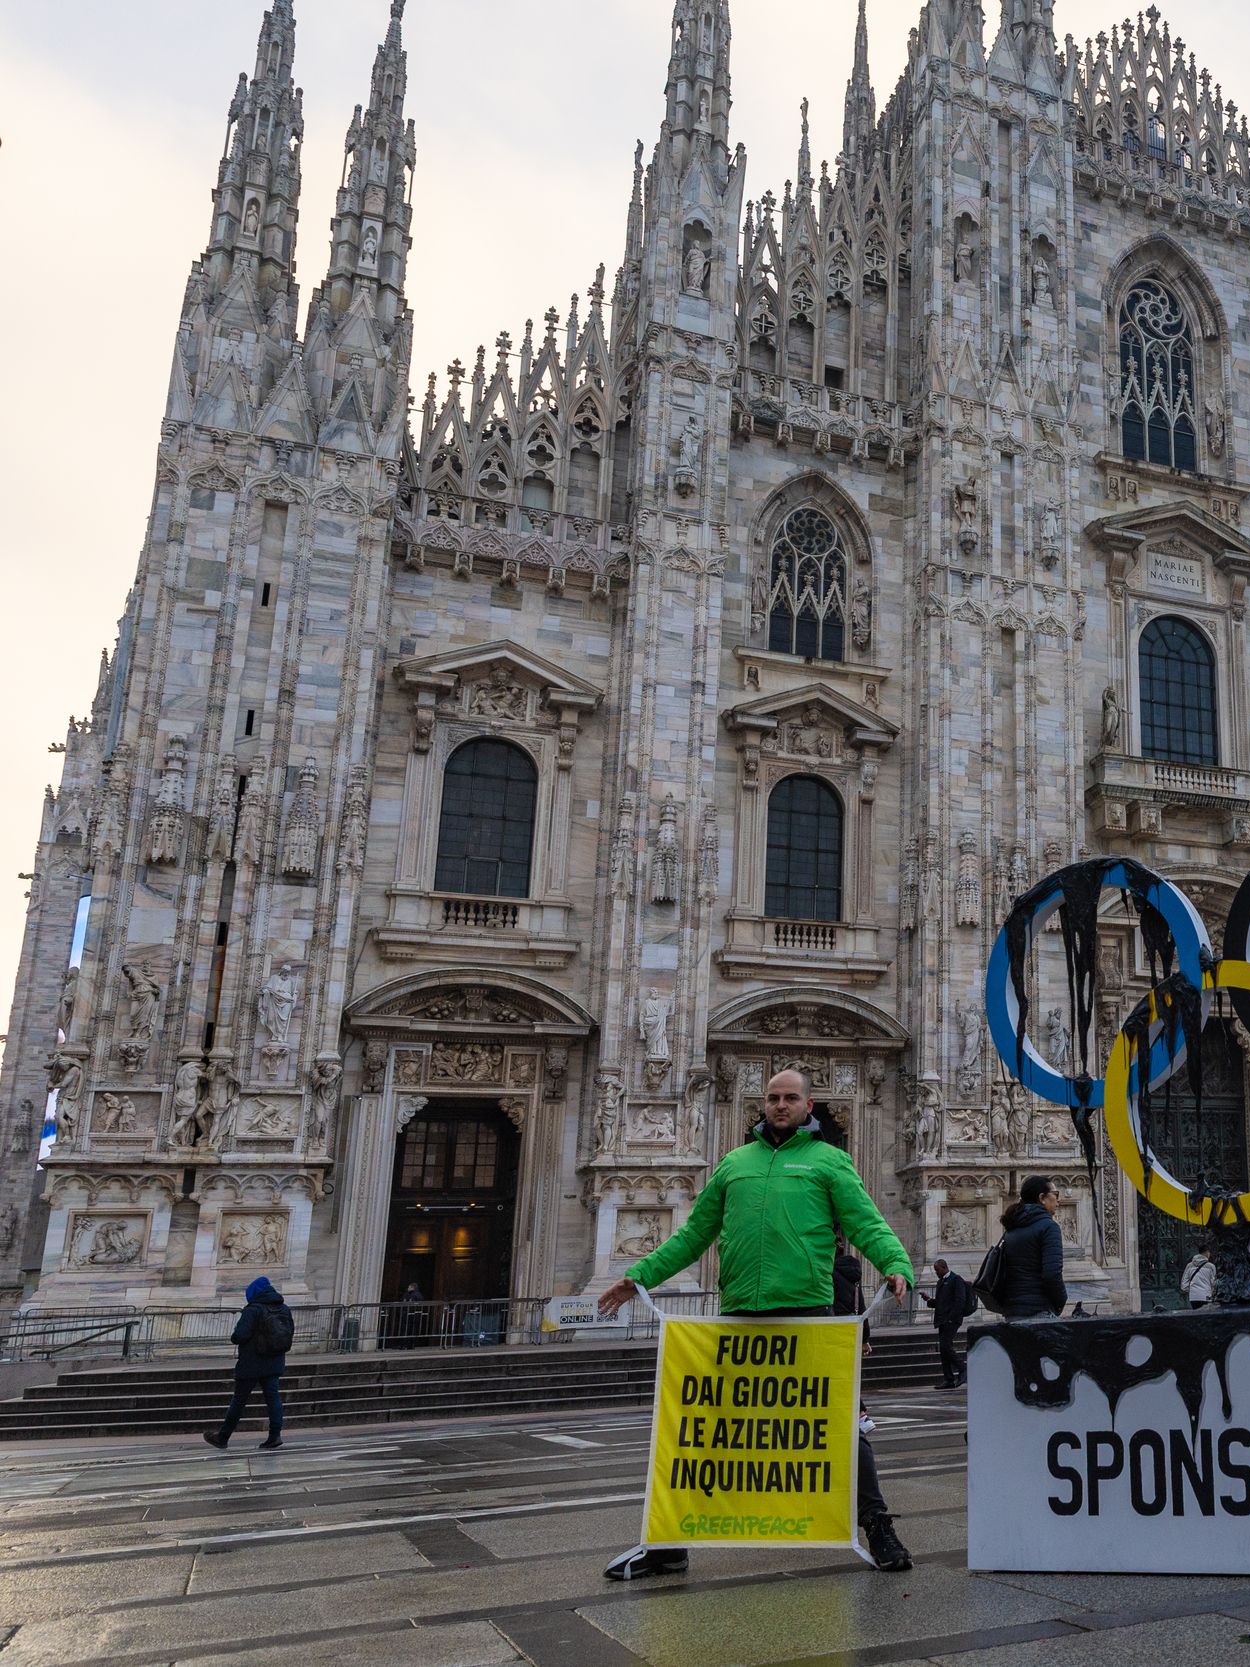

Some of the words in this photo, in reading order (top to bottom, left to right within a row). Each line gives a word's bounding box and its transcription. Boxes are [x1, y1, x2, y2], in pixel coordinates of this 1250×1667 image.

[1150, 571, 1200, 587] NASCENTI
[1154, 559, 1194, 573] MARIAE
[560, 1315, 593, 1323] ONLINE
[716, 1335, 798, 1366] FUORI
[681, 1375, 725, 1407] DAI
[732, 1376, 830, 1408] GIOCHI
[678, 1416, 706, 1448] LE
[711, 1418, 829, 1450] AZIENDE
[670, 1458, 831, 1498] INQUINANTI
[679, 1513, 815, 1537] GREENPEACE
